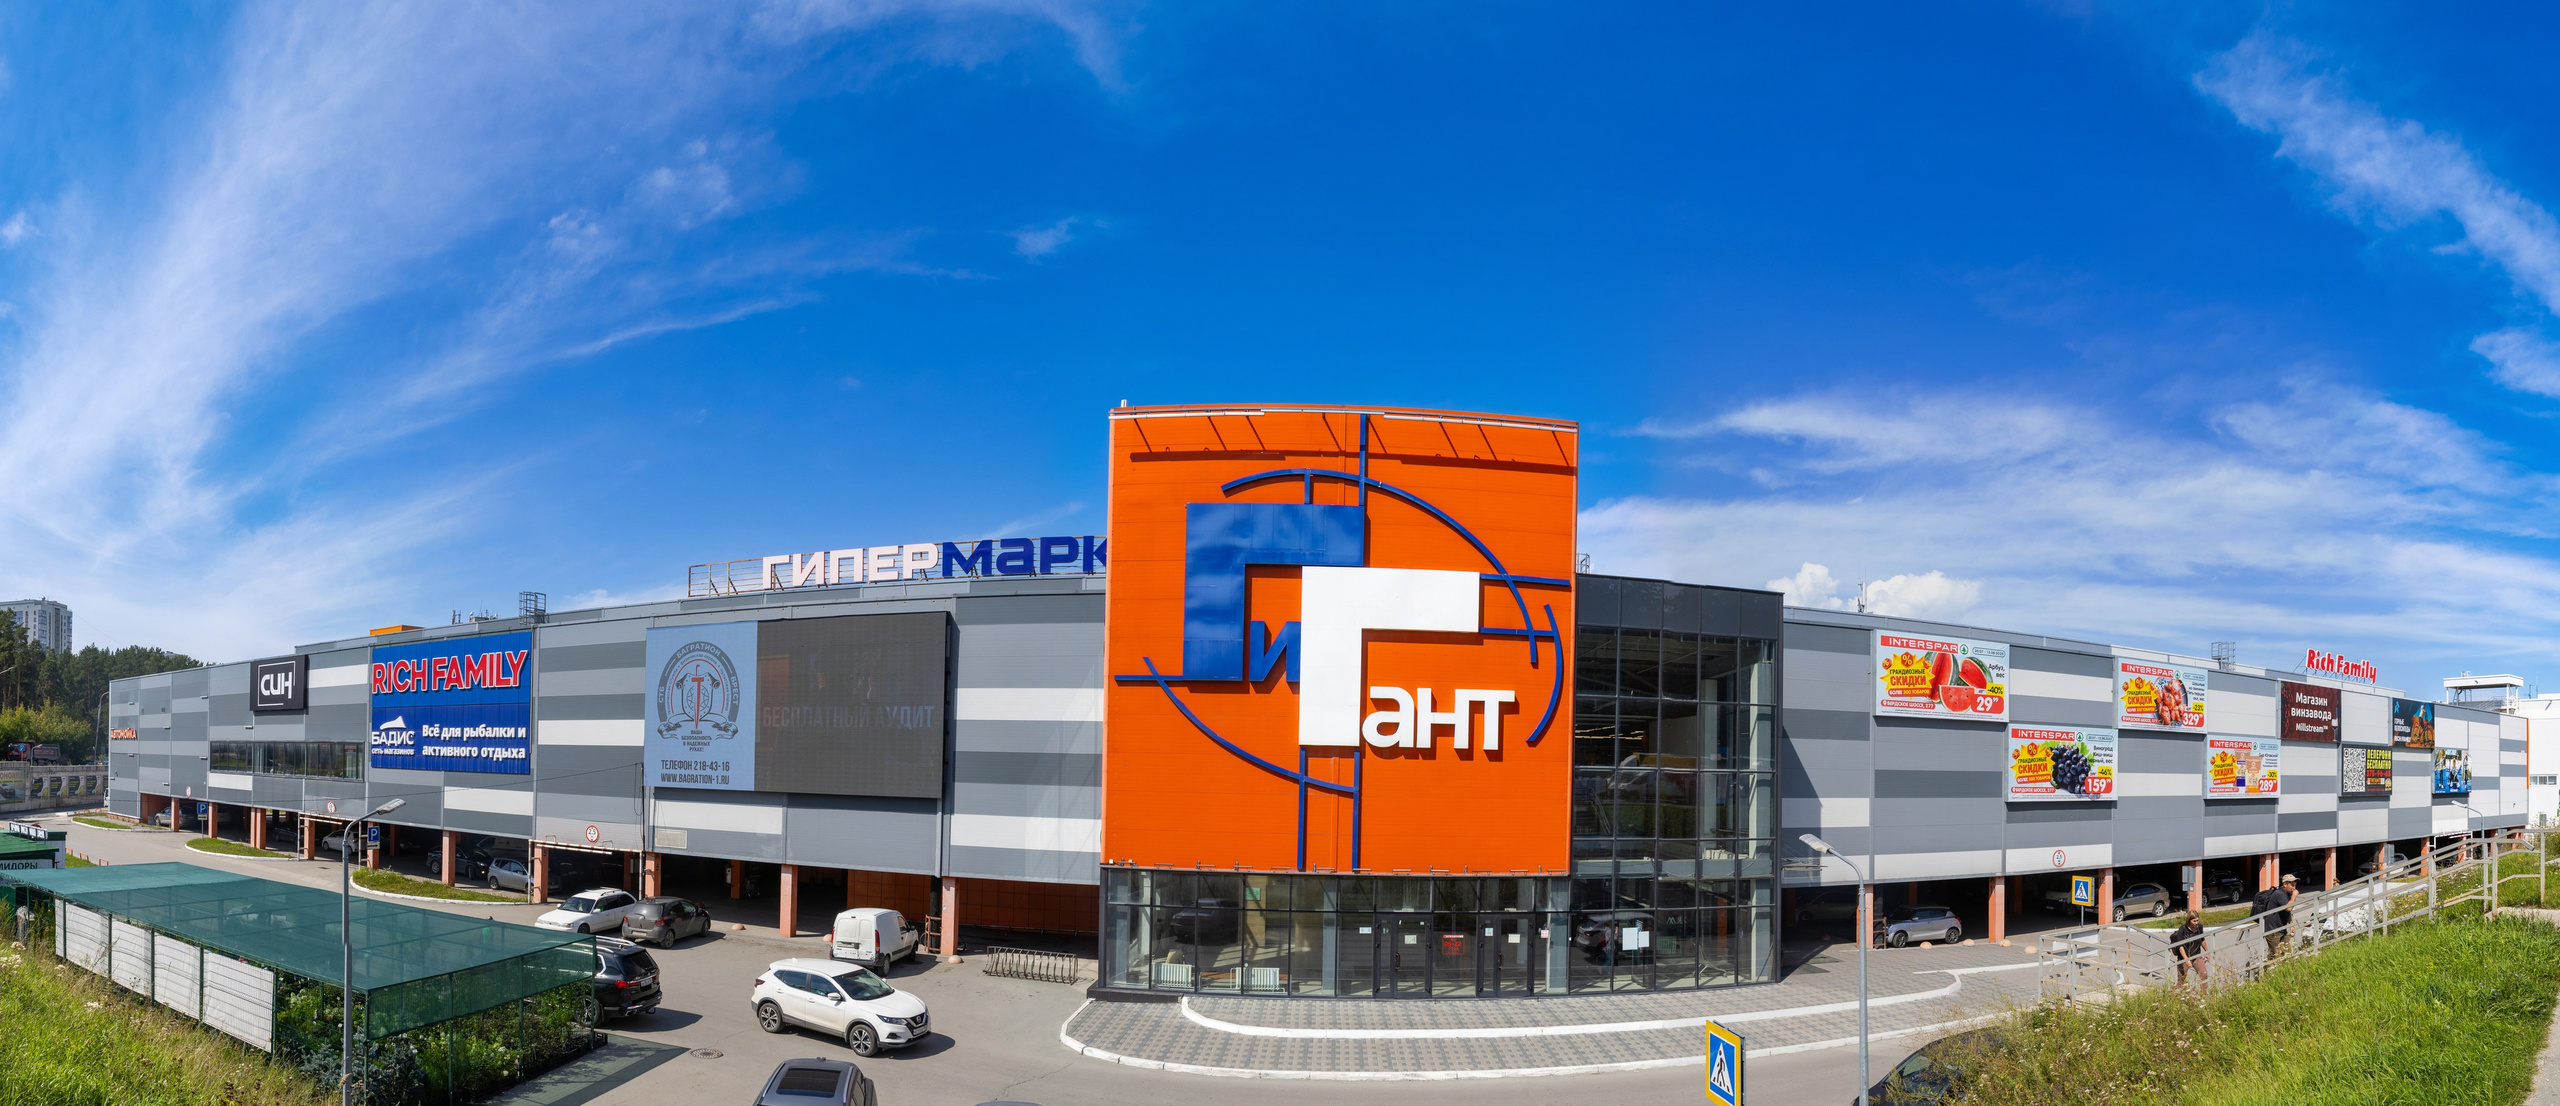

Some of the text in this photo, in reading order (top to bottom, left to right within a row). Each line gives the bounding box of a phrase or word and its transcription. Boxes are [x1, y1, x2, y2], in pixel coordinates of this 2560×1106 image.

[676, 643, 722, 659] БАГРАТИОН
[1889, 638, 1958, 652] INTERSPAR
[372, 650, 528, 694] RICH FAMILY
[2126, 665, 2174, 677] INTERSPAR
[2306, 648, 2376, 684] Rich Family
[1890, 676, 1926, 687] СКИДКИ
[730, 676, 739, 705] БРЕСТ
[1988, 687, 2003, 695] -40%
[1976, 697, 1993, 711] 29
[2128, 696, 2152, 705] СКИДКИ
[2296, 692, 2328, 706] Магазин
[763, 704, 934, 729] БЕСПЛАТНЫЙ АУДИТ
[2183, 713, 2199, 725] 329
[2291, 707, 2332, 721] винзавода
[111, 728, 137, 740] АВТОМОЙКА
[372, 730, 415, 747] БАДИС
[422, 724, 526, 741] Всё для рыбалки и
[2018, 730, 2075, 740] INTERSPAR
[422, 745, 526, 761] активного отдыха
[661, 760, 730, 771] ТЕЛЕФОН 218-43-16
[2018, 763, 2048, 774] СКИДКИ
[661, 773, 729, 784] WWW.BAGRATION-1.RU
[2087, 779, 2106, 792] 159
[2259, 780, 2273, 791] 289
